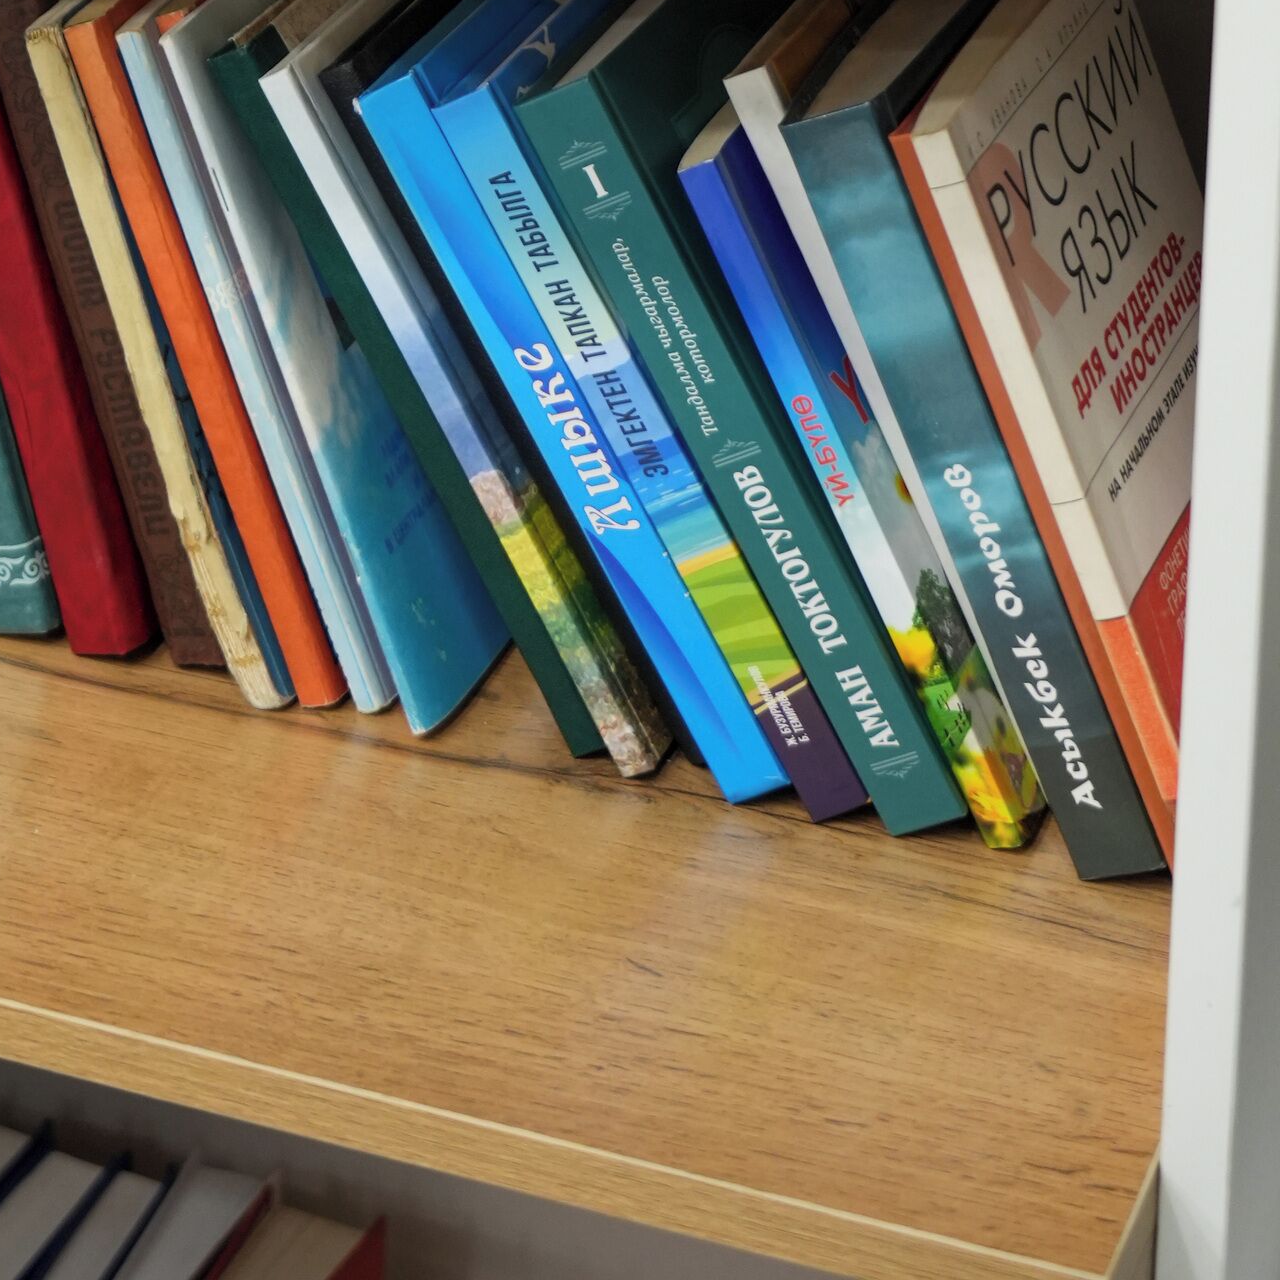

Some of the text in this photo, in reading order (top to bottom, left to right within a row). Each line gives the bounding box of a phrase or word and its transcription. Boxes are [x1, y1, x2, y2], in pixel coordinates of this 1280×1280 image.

[1060, 141, 1158, 314] ЯЗЫК
[488, 170, 669, 478] ЭМГЕКТЕН ТАПКАН ТАБЫЛГА
[651, 275, 714, 385] котормолор
[661, 347, 721, 438] Тандалма
[1070, 230, 1185, 419] ДЛЯ СТУДЕНТОВ-
[514, 341, 640, 534] Ашыке
[791, 395, 857, 508] ҮЙ-БҮЛӨ
[1108, 475, 1121, 502] НА
[1119, 407, 1165, 483] НАЧАЛЬНОМ
[1162, 371, 1184, 414] ЭТАПЕ
[733, 464, 900, 750] АМАН ТОКТОГУЛОВ
[944, 463, 1103, 810] Асыкбек Оморов
